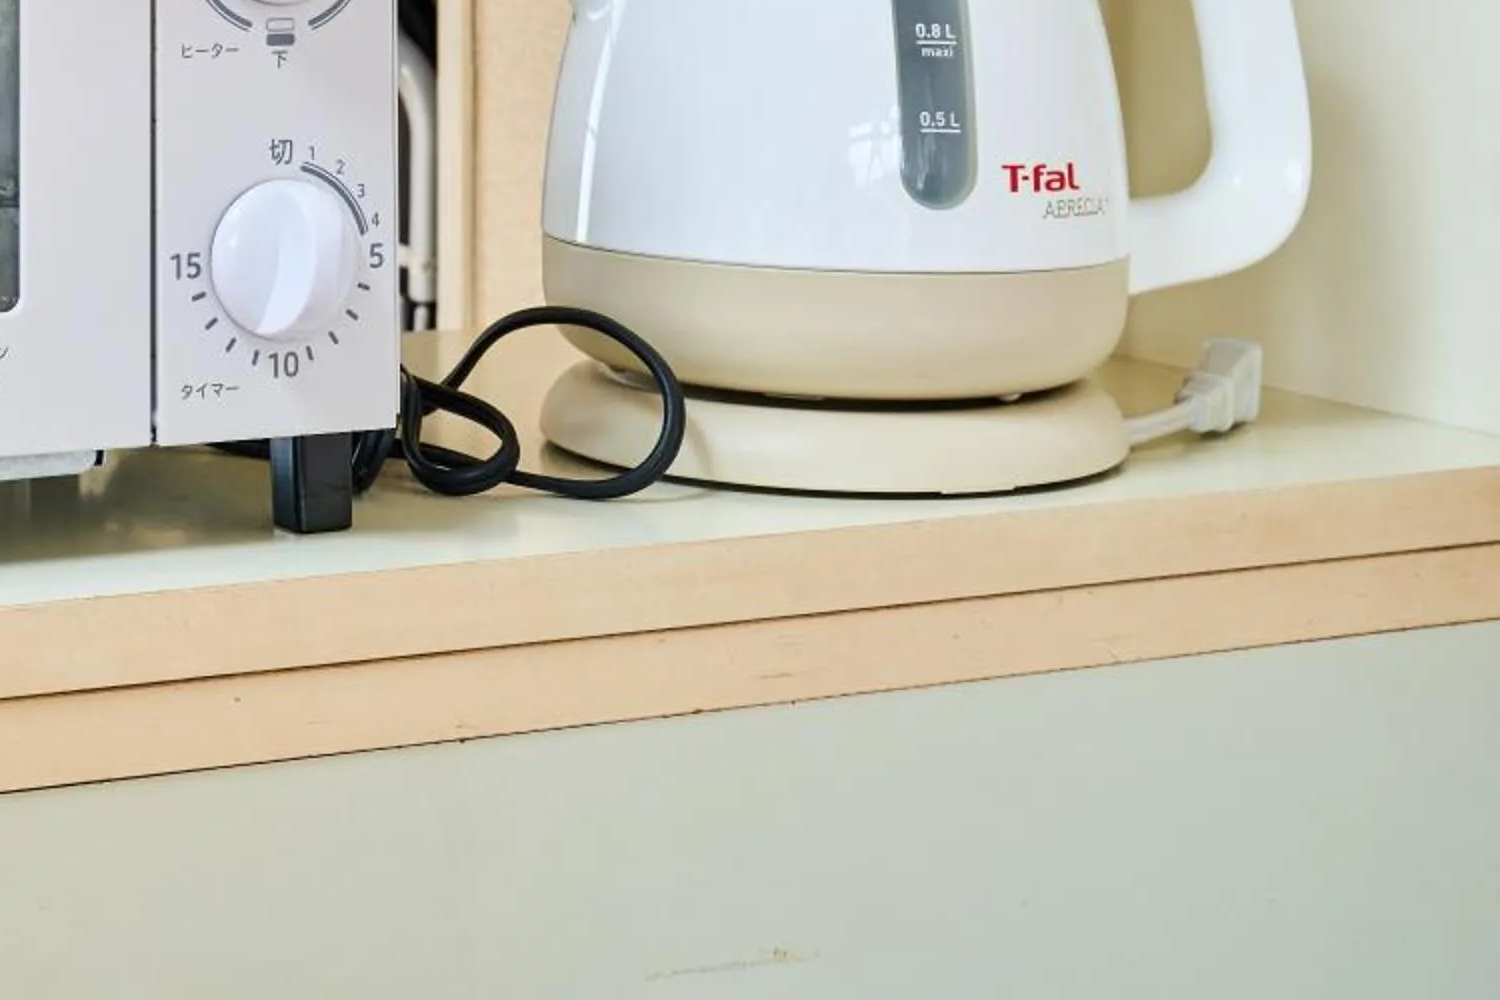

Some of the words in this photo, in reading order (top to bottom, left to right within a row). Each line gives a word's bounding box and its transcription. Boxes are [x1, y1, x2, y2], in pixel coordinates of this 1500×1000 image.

[915, 23, 941, 39] 0.8
[945, 23, 957, 39] L
[180, 42, 240, 59] ヒーター
[921, 46, 954, 57] maxi
[271, 50, 289, 69] 下
[919, 111, 945, 127] 0.5
[950, 112, 961, 127] L
[269, 138, 293, 165] 切
[308, 146, 317, 160] 1
[335, 159, 346, 175] 2
[1001, 162, 1080, 192] T-fal
[357, 183, 366, 199] 3
[371, 211, 381, 227] 4
[369, 242, 384, 269] 5
[169, 252, 203, 280] 15
[268, 351, 299, 379] 10
[181, 383, 240, 400] タイマー
